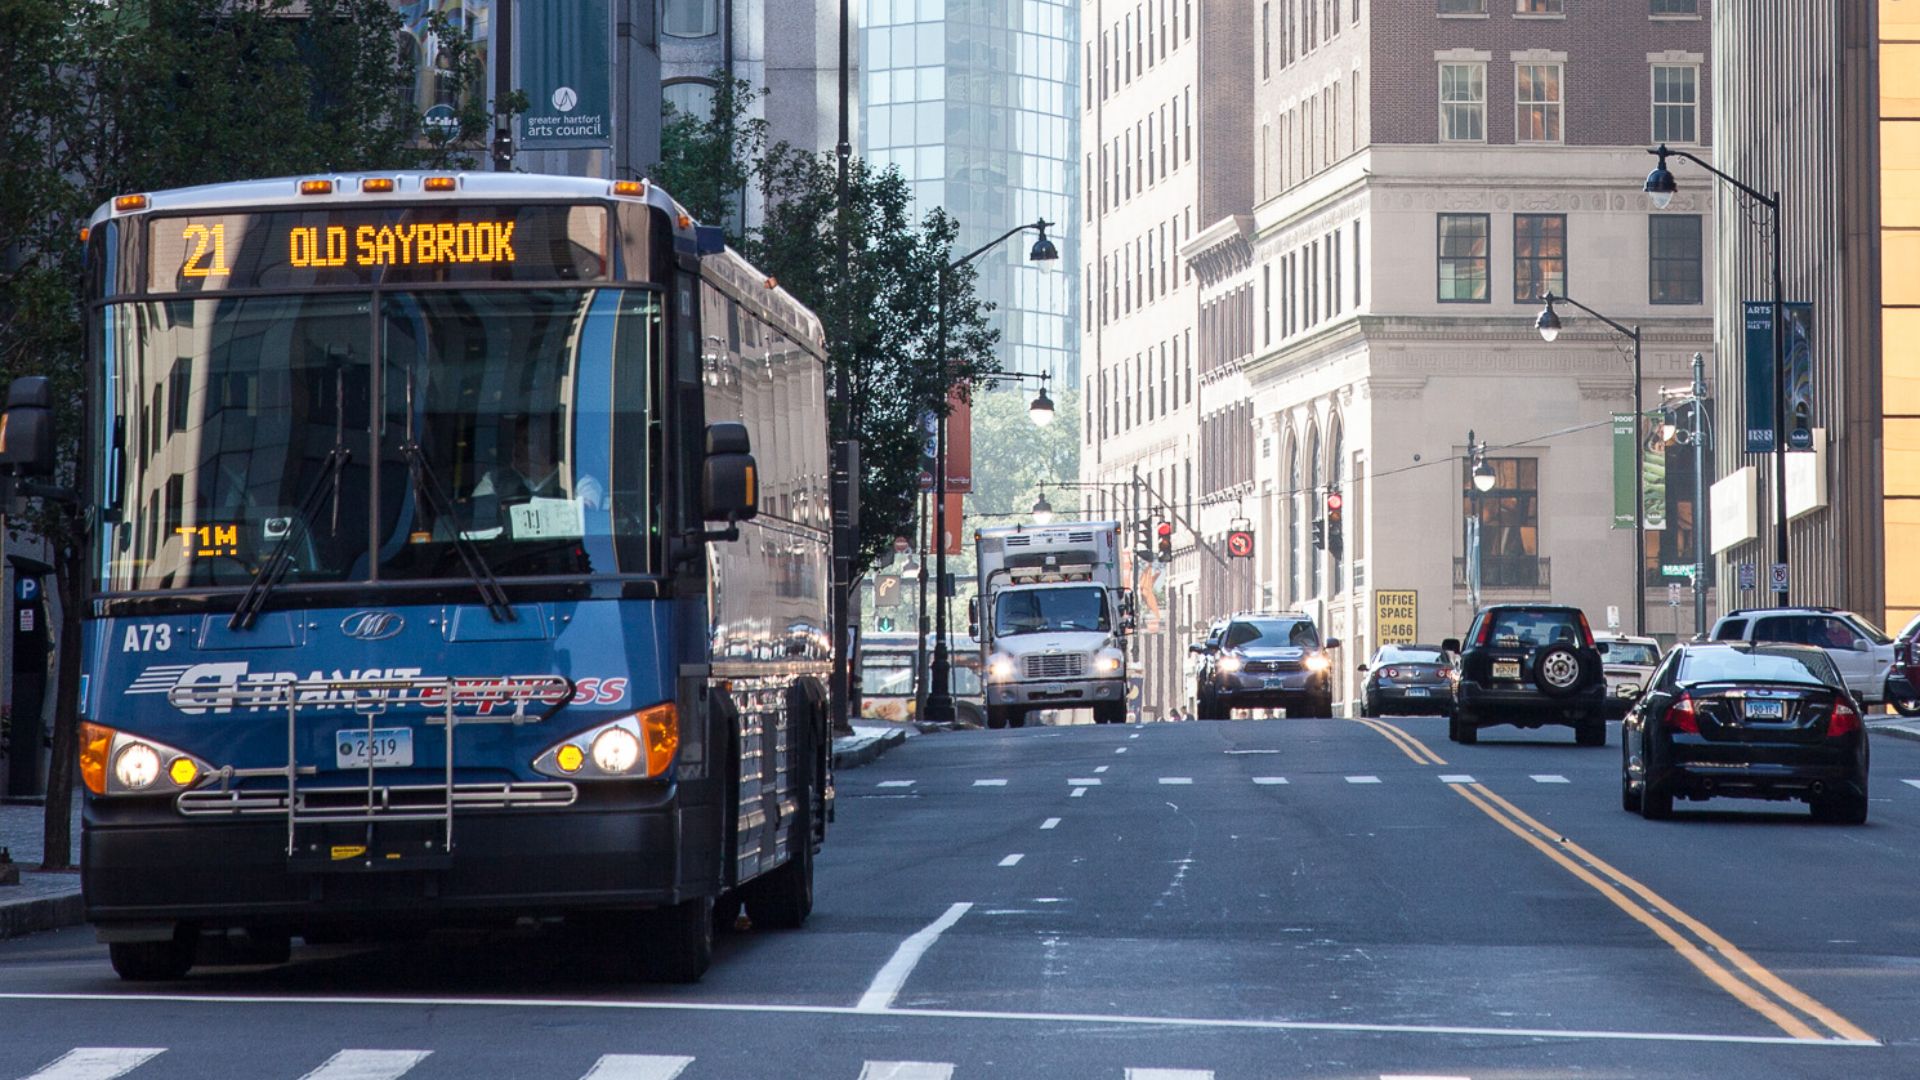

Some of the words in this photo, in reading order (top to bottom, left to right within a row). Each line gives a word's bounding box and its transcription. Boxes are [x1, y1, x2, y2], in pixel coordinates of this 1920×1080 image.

[528, 116, 561, 126] greater
[563, 115, 601, 124] hartford
[528, 125, 552, 136] arts
[556, 123, 602, 136] council
[183, 224, 230, 277] 21
[290, 227, 347, 267] OLD
[356, 221, 516, 265] SAYBROOK
[1747, 306, 1771, 314] ARTS
[175, 525, 237, 557] T1M
[1662, 565, 1689, 573] MAIN
[22, 578, 36, 600] P
[1380, 594, 1415, 606] OFFICE
[1380, 607, 1414, 619] SPACE
[122, 623, 172, 653] A73
[420, 677, 628, 715] express
